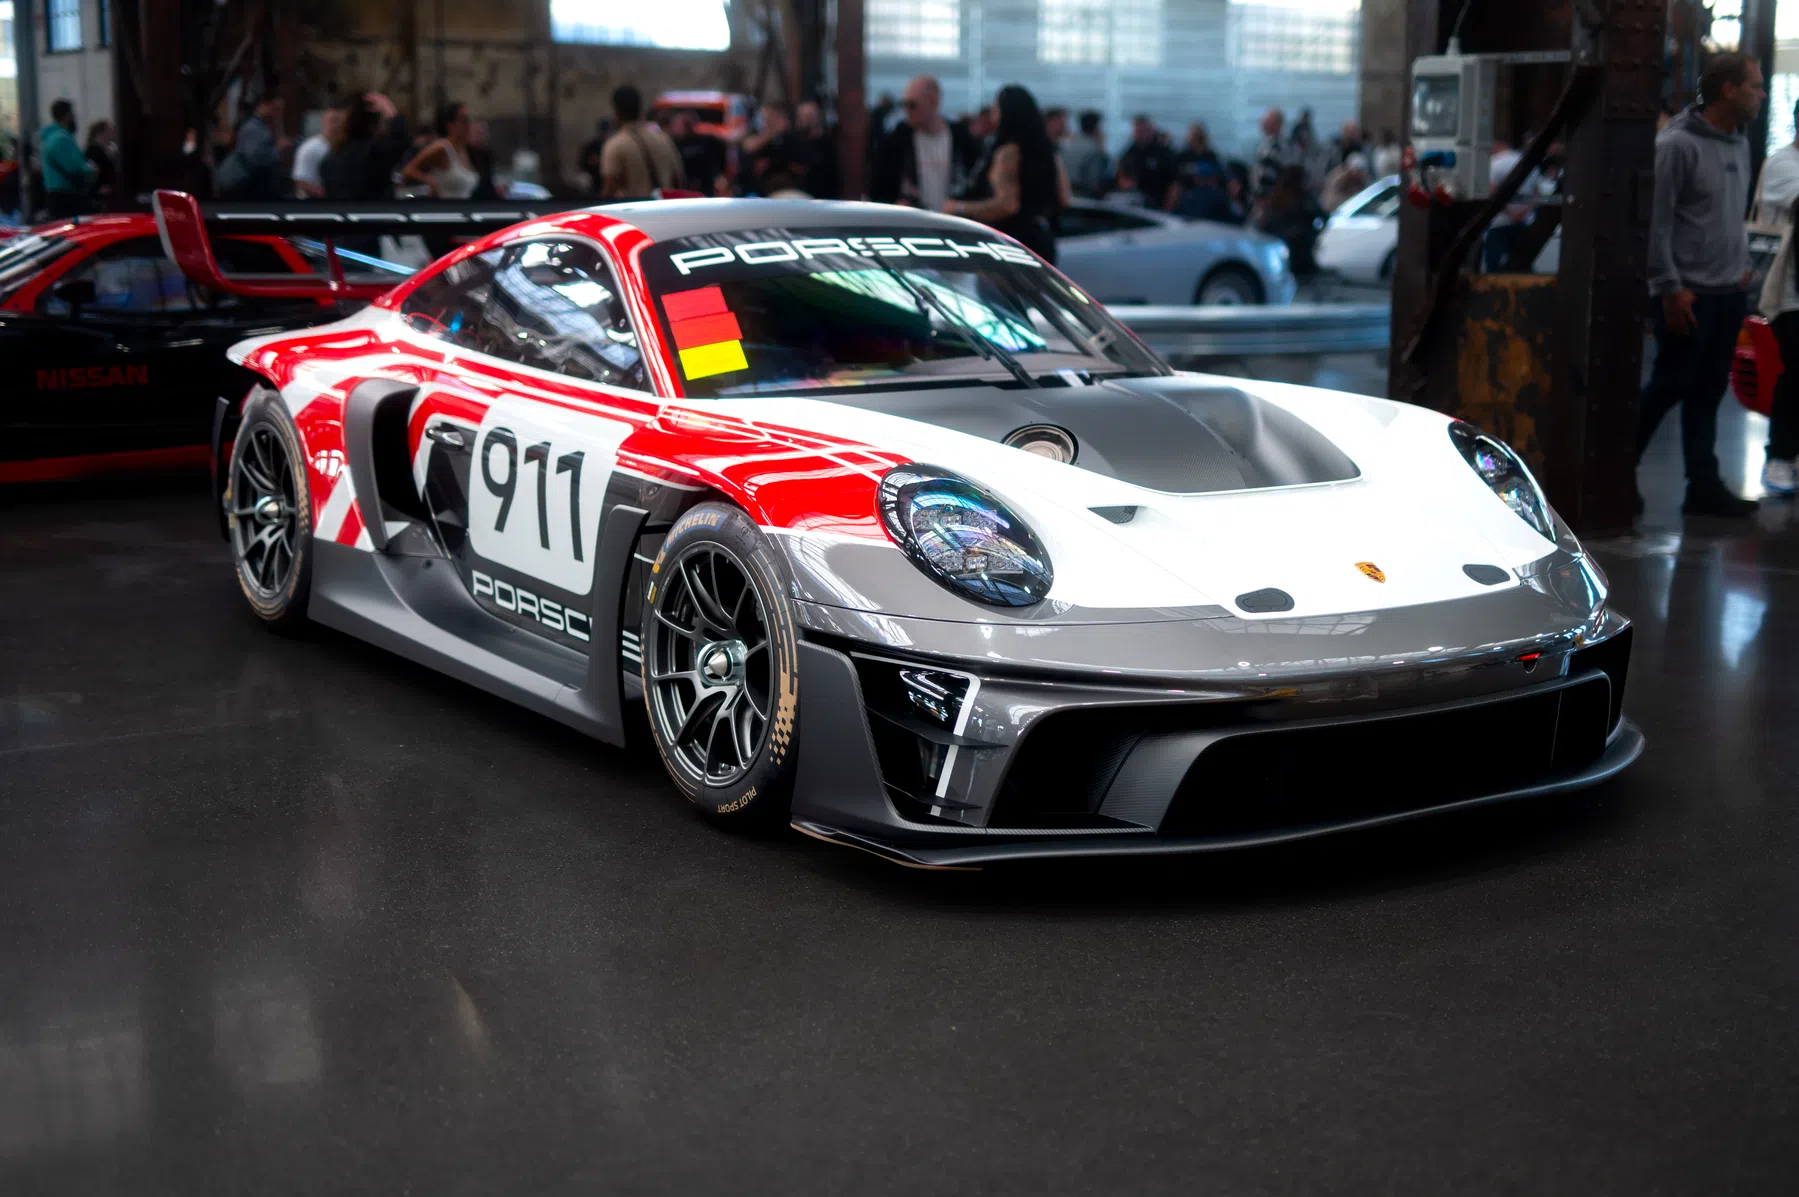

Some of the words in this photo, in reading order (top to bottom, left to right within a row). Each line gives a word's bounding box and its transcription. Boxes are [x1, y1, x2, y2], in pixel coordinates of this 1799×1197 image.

[671, 237, 1042, 275] PORSCHE
[36, 365, 149, 390] NISSAN
[481, 427, 585, 563] 911
[666, 512, 721, 549] MICHELIN
[717, 800, 739, 813] SPORT
[739, 785, 757, 808] PILOT
